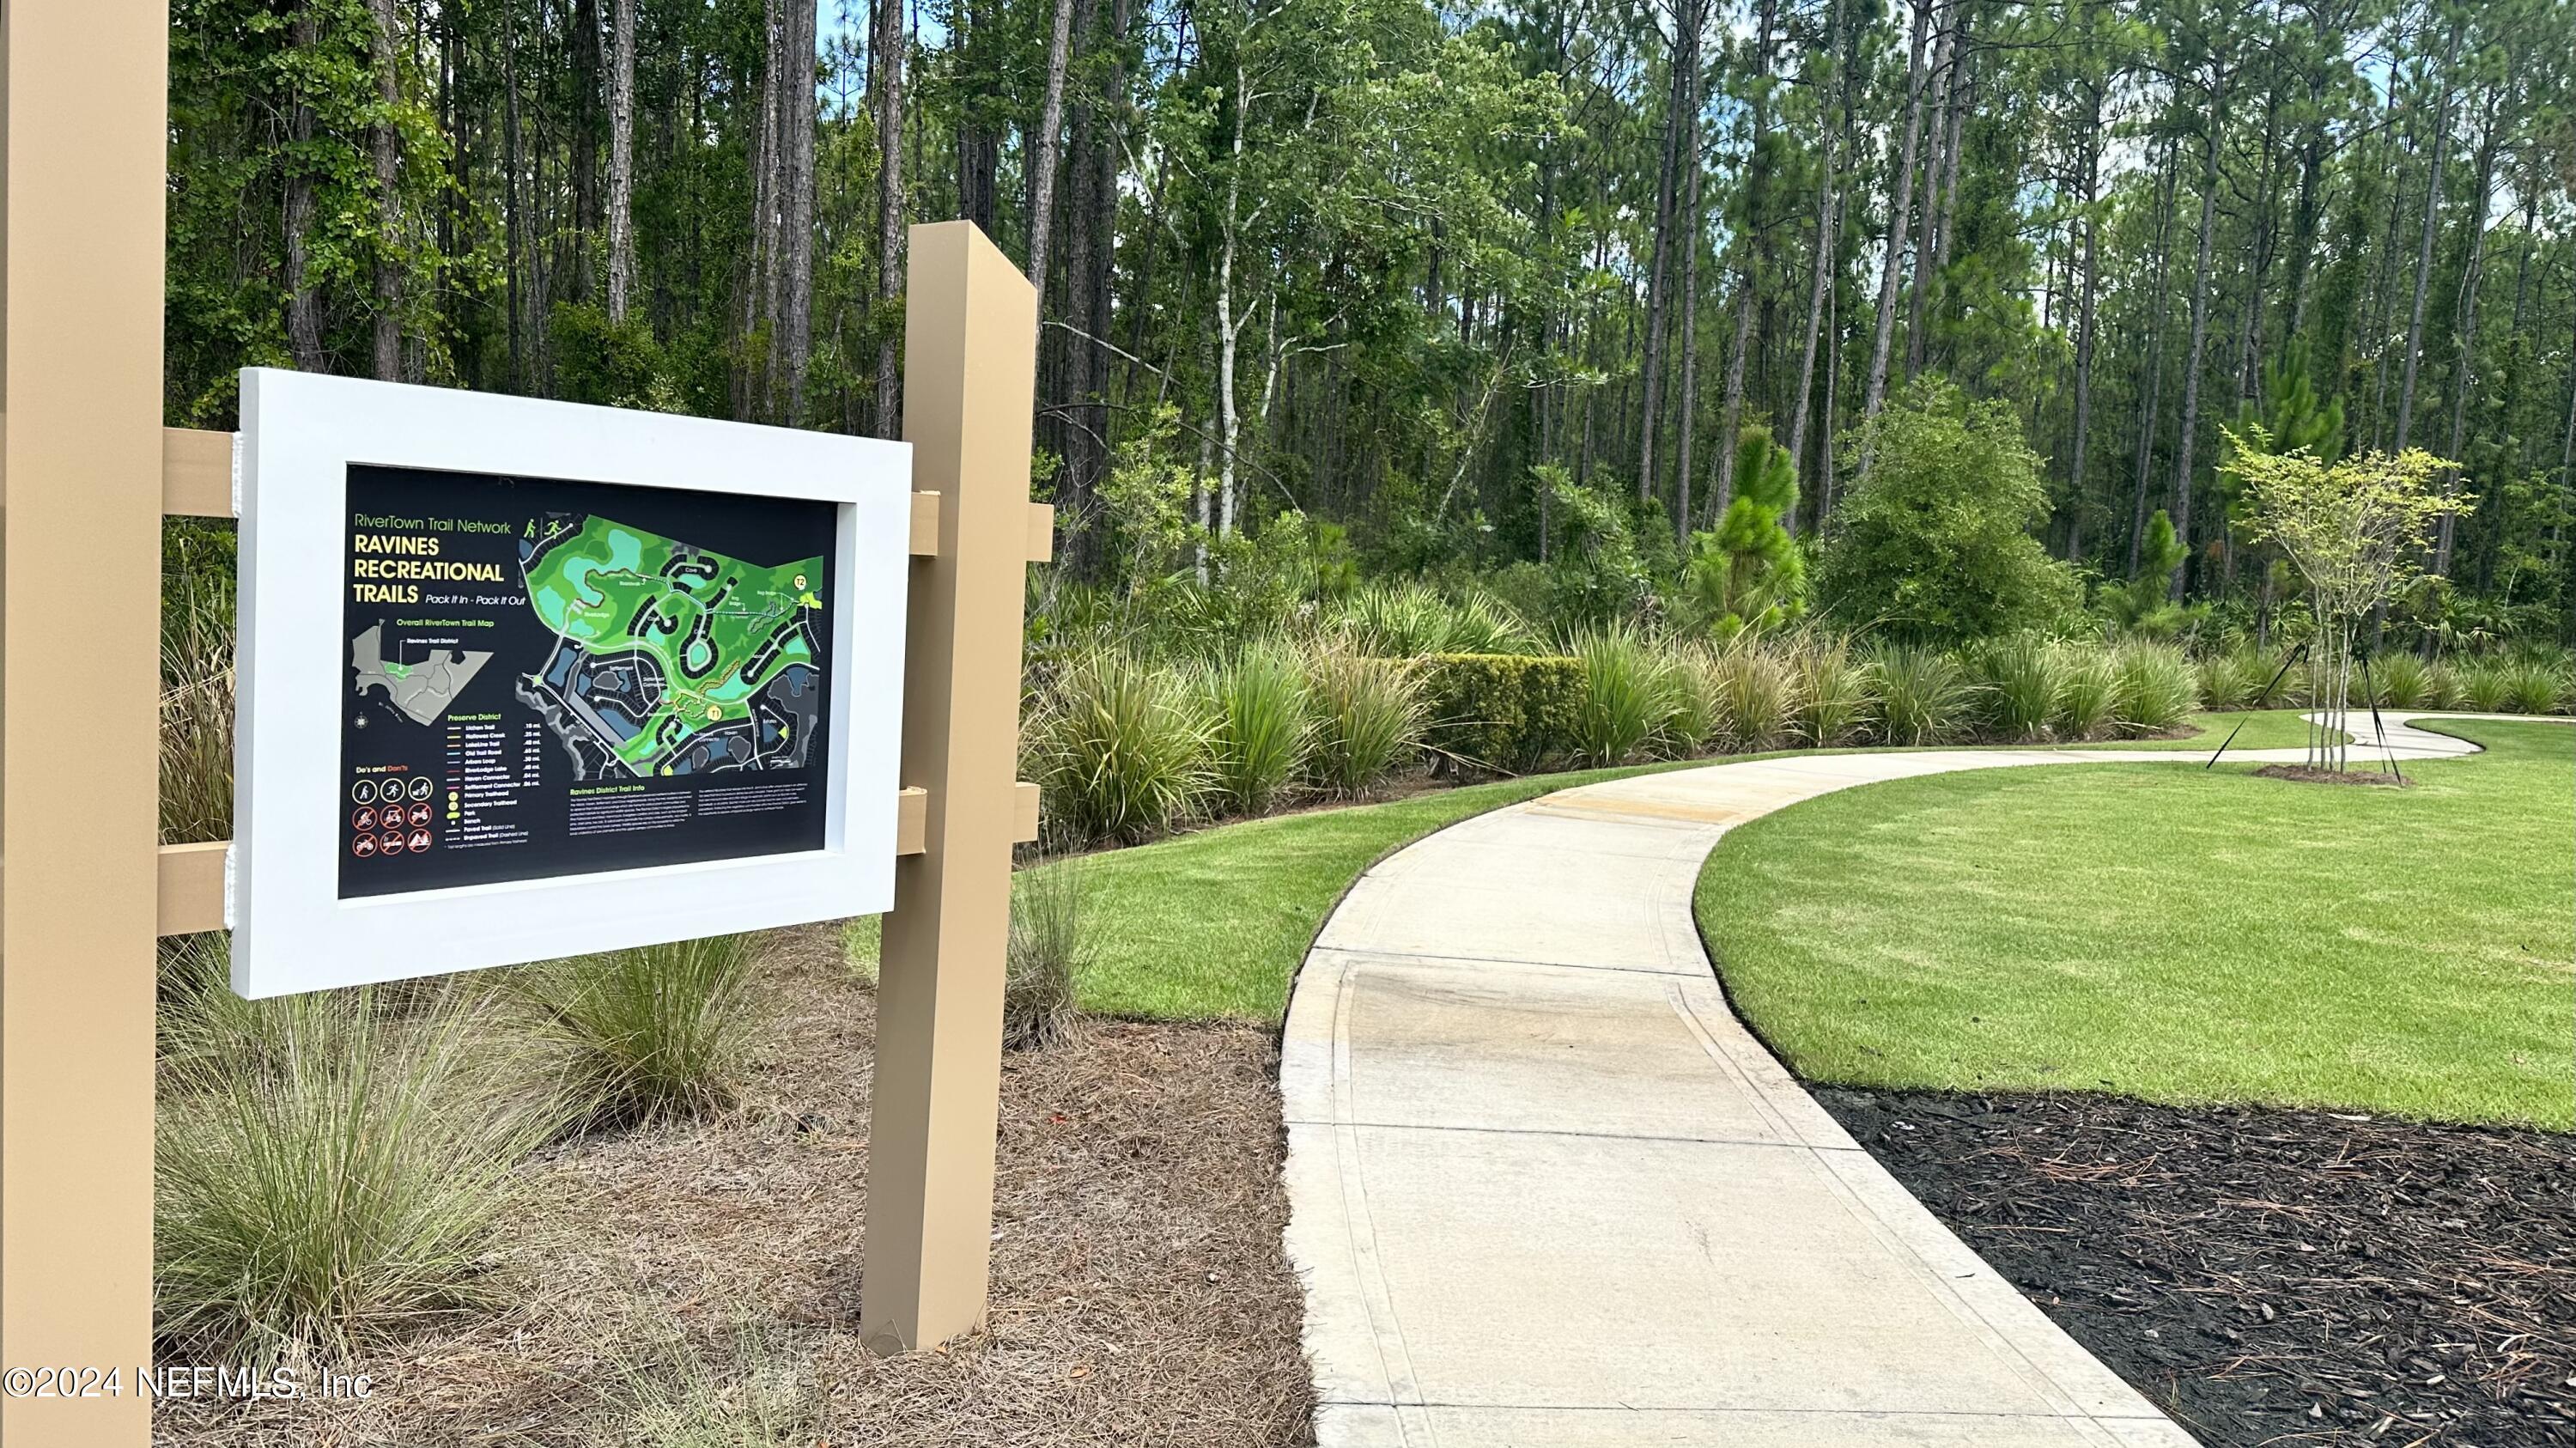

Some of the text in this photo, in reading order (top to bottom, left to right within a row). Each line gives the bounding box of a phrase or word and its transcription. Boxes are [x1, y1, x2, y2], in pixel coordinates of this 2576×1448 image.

[355, 514, 511, 534] RiverTown Trail Network
[355, 534, 439, 556] RAVINES
[354, 559, 504, 582] RECREATIONAL
[353, 584, 419, 604] TRAILS
[425, 595, 450, 604] Pack
[451, 595, 458, 604] It
[459, 595, 468, 604] In
[476, 596, 500, 605] Pack
[501, 596, 507, 605] It
[508, 596, 526, 605] Out
